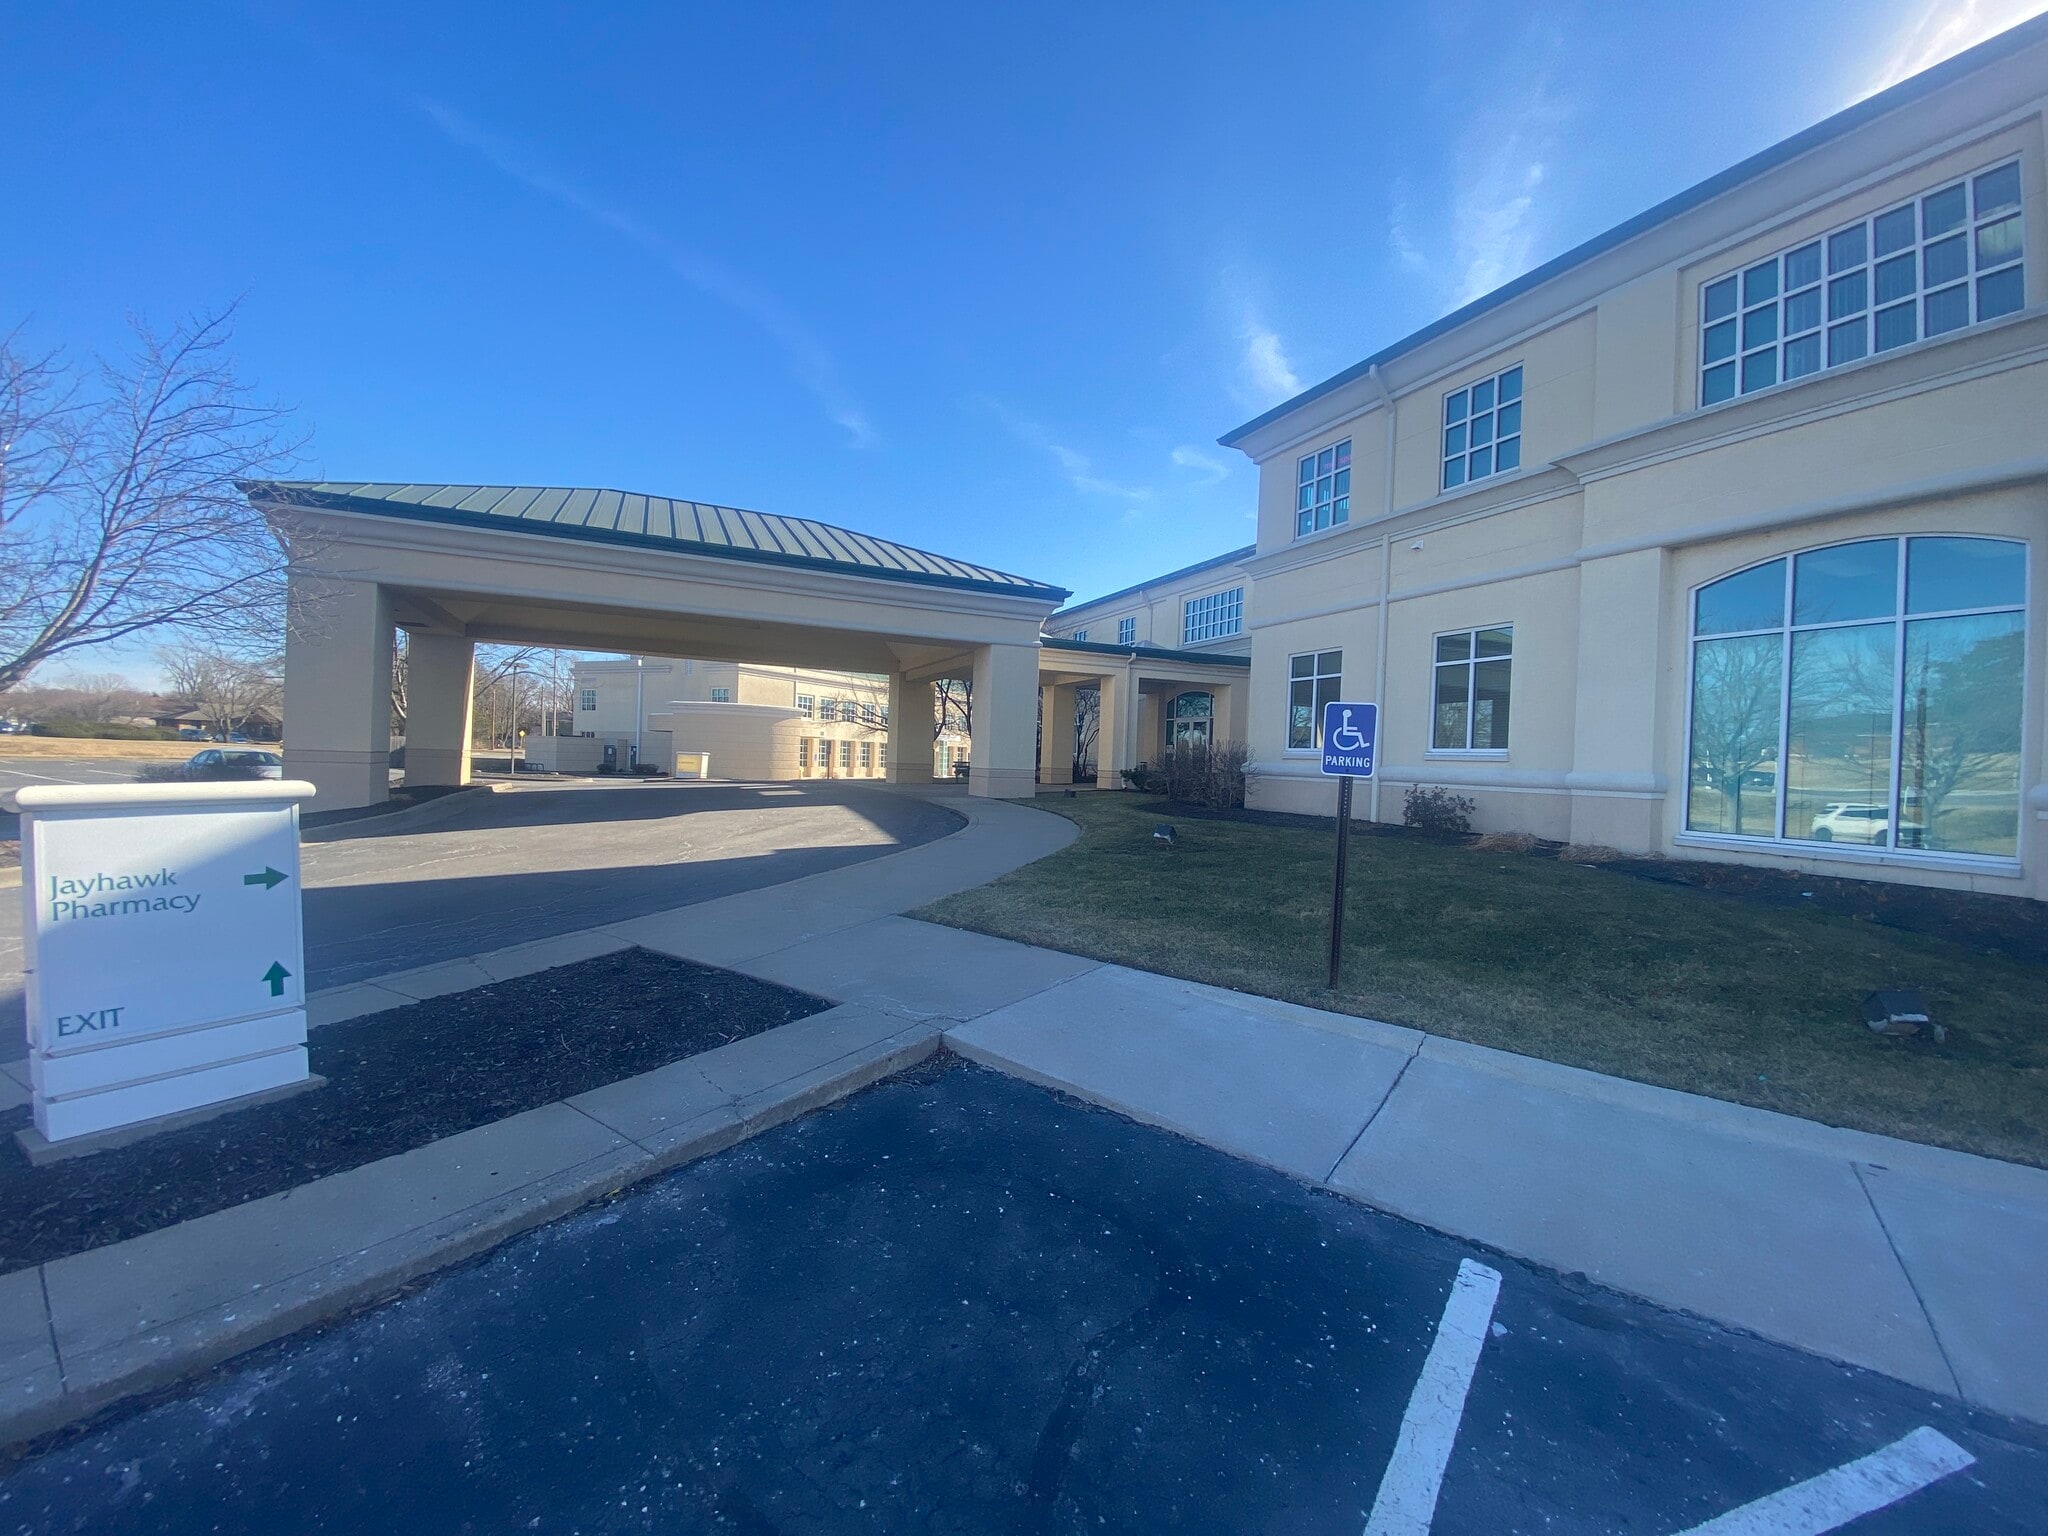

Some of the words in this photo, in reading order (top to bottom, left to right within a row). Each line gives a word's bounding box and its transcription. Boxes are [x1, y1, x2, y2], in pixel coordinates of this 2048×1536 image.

[1325, 755, 1371, 768] PARKING
[50, 867, 177, 902] Jayhawk
[52, 893, 201, 922] Pharmacy
[57, 1006, 125, 1037] EXIT
